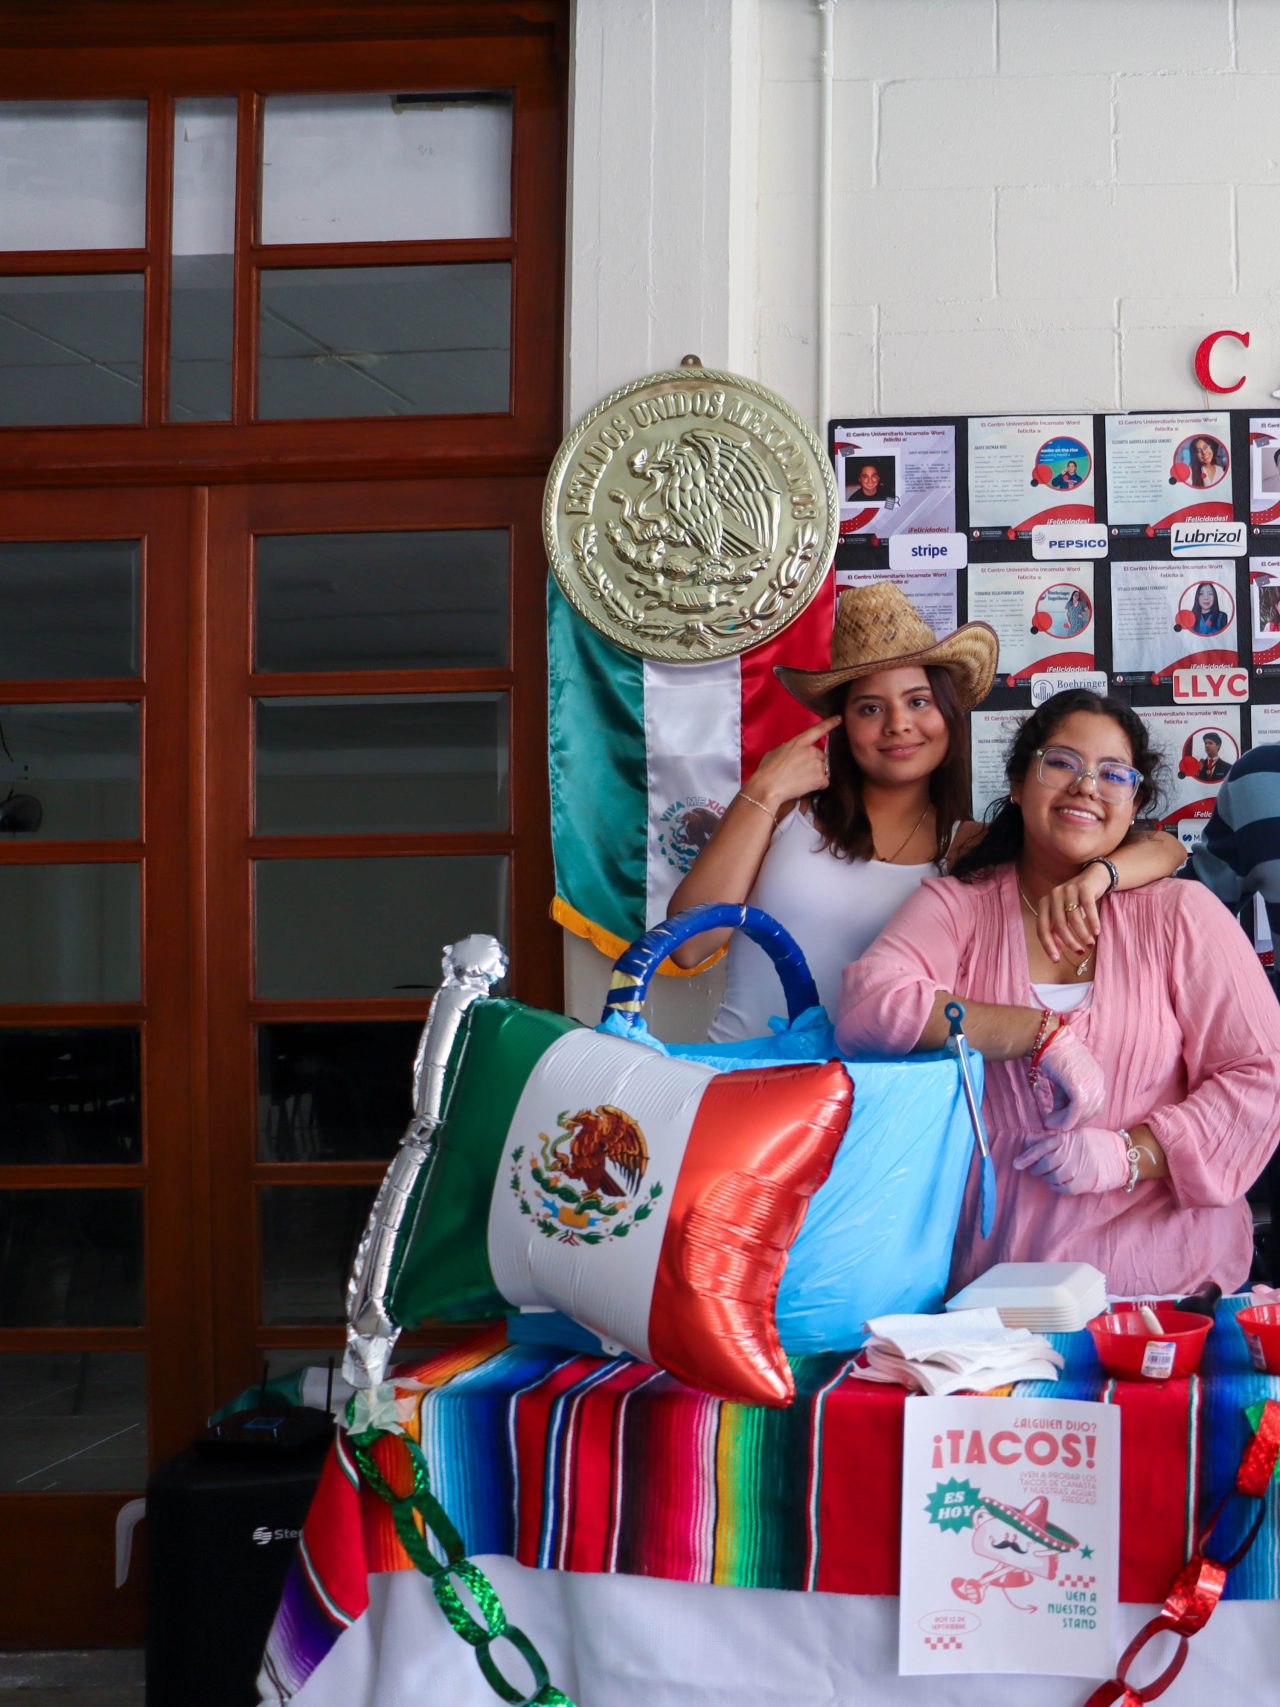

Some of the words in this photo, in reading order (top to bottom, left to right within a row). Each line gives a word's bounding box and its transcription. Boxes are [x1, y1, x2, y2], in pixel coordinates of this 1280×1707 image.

[565, 414, 634, 515] ESTADOS
[629, 391, 725, 428] UNIDOS
[725, 396, 818, 520] MEXICANOS
[1174, 529, 1242, 544] Lubrizol
[911, 544, 948, 558] stripe
[1049, 539, 1107, 549] PEPSICO
[1057, 679, 1106, 689] Boehringer
[1174, 673, 1248, 698] LLYC
[660, 801, 685, 822] VIVA
[687, 796, 728, 816] MEXIC
[1013, 1417, 1063, 1430] ¿ALGUIEN
[1065, 1420, 1097, 1432] DIJO?
[931, 1429, 1097, 1469] ¡TACOS!
[943, 1491, 965, 1505] ES
[937, 1505, 975, 1520] HOY
[274, 1529, 301, 1540] Ste
[1066, 1591, 1086, 1602] VEN
[1088, 1592, 1097, 1602] A
[1047, 1603, 1097, 1616] NUESTRO
[1062, 1618, 1097, 1630] STAND
